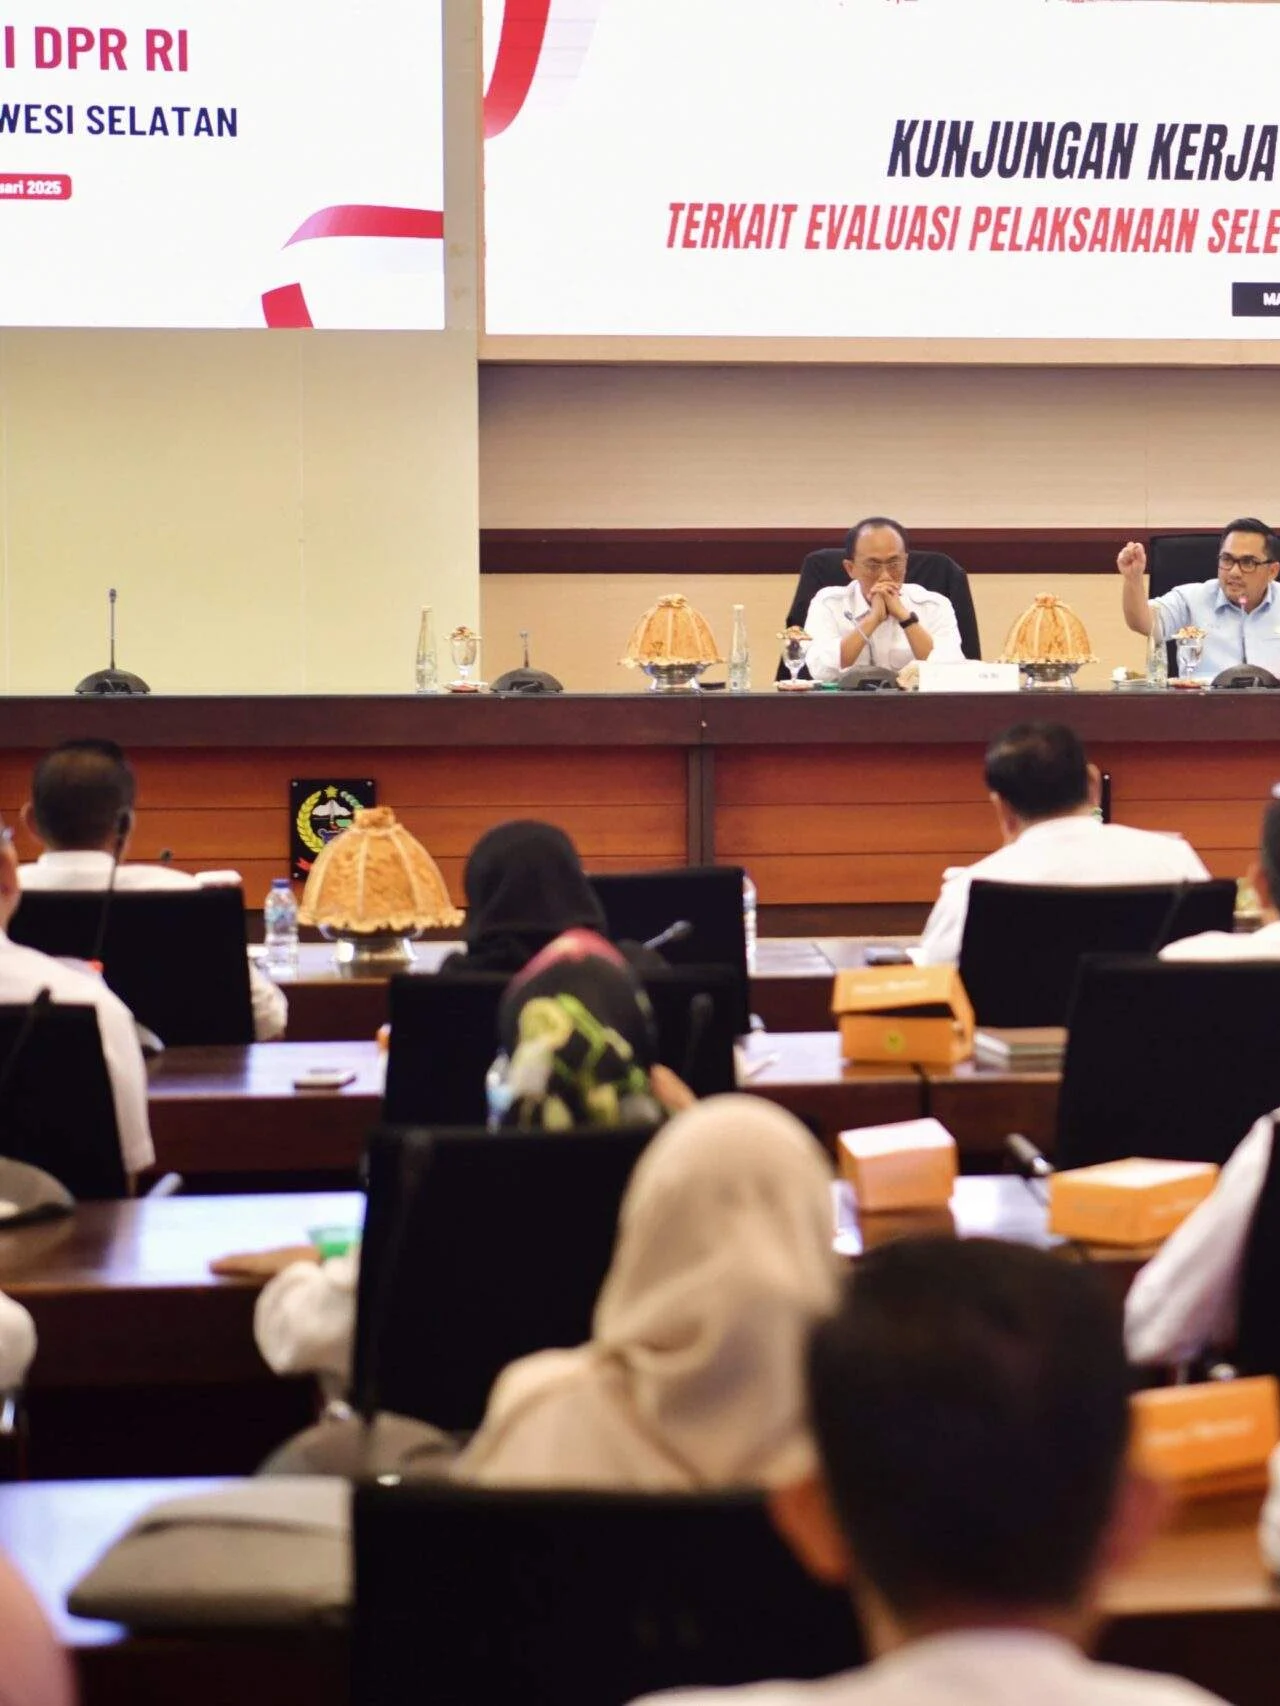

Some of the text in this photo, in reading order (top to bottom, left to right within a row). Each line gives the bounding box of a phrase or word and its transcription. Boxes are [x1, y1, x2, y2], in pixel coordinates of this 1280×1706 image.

[35, 27, 128, 71] DPR
[146, 29, 188, 72] RI
[86, 105, 238, 138] SELATAN
[887, 120, 1138, 180] KUNJUNGAN
[1148, 123, 1279, 182] KERJA
[27, 180, 62, 195] 2025
[666, 203, 798, 249] TERKAIT
[804, 205, 962, 251] EVALUASI
[969, 206, 1200, 253] PELAKSANAAN
